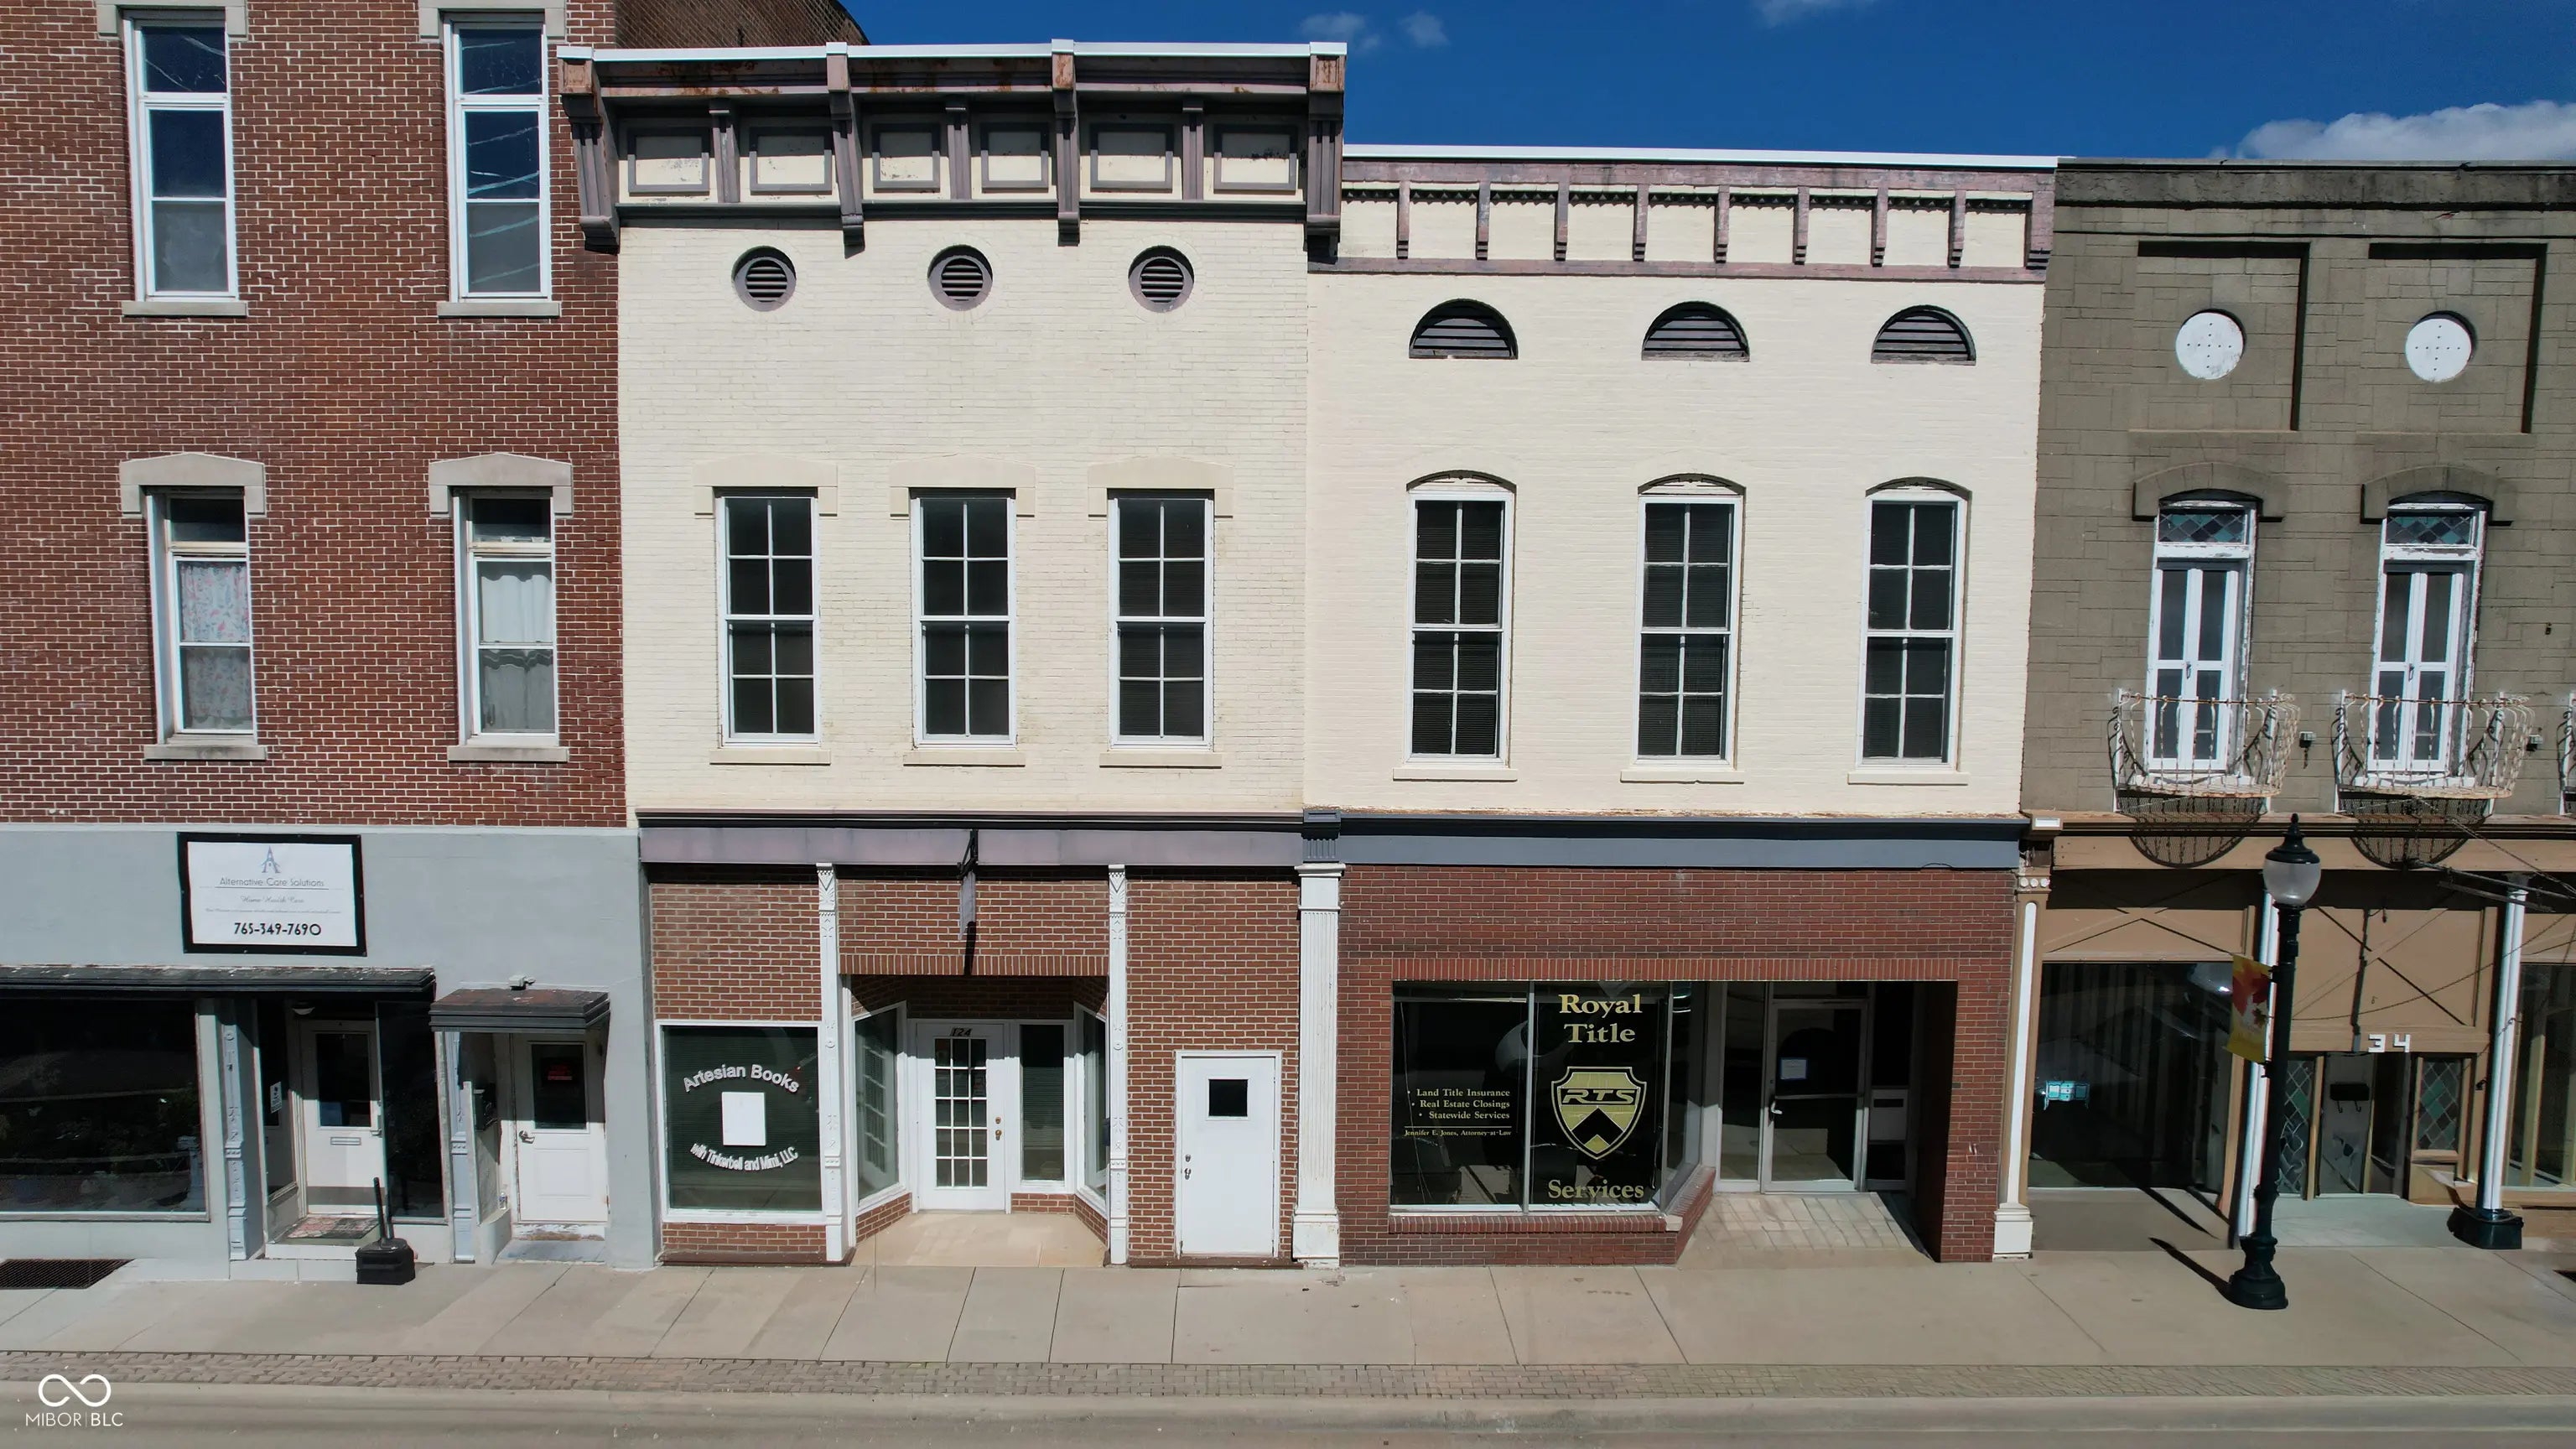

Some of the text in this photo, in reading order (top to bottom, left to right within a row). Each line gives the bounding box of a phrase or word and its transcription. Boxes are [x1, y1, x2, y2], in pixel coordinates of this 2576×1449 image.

[220, 877, 325, 887] Alternative Care Solutions
[234, 922, 322, 936] 765-349-7690
[1558, 994, 1643, 1018] Royal
[950, 1027, 972, 1036] 124
[1564, 1023, 1636, 1043] Title
[683, 1064, 800, 1093] Artesian Books
[1416, 1088, 1510, 1097] Land Title Insurance
[1562, 1089, 1635, 1104] RTS
[1420, 1099, 1510, 1109] Real Estate Closings
[1429, 1111, 1510, 1119] Statewide Services
[690, 1143, 798, 1171] with Tinkerbell and Mimi, LLC
[1548, 1179, 1644, 1199] Services
